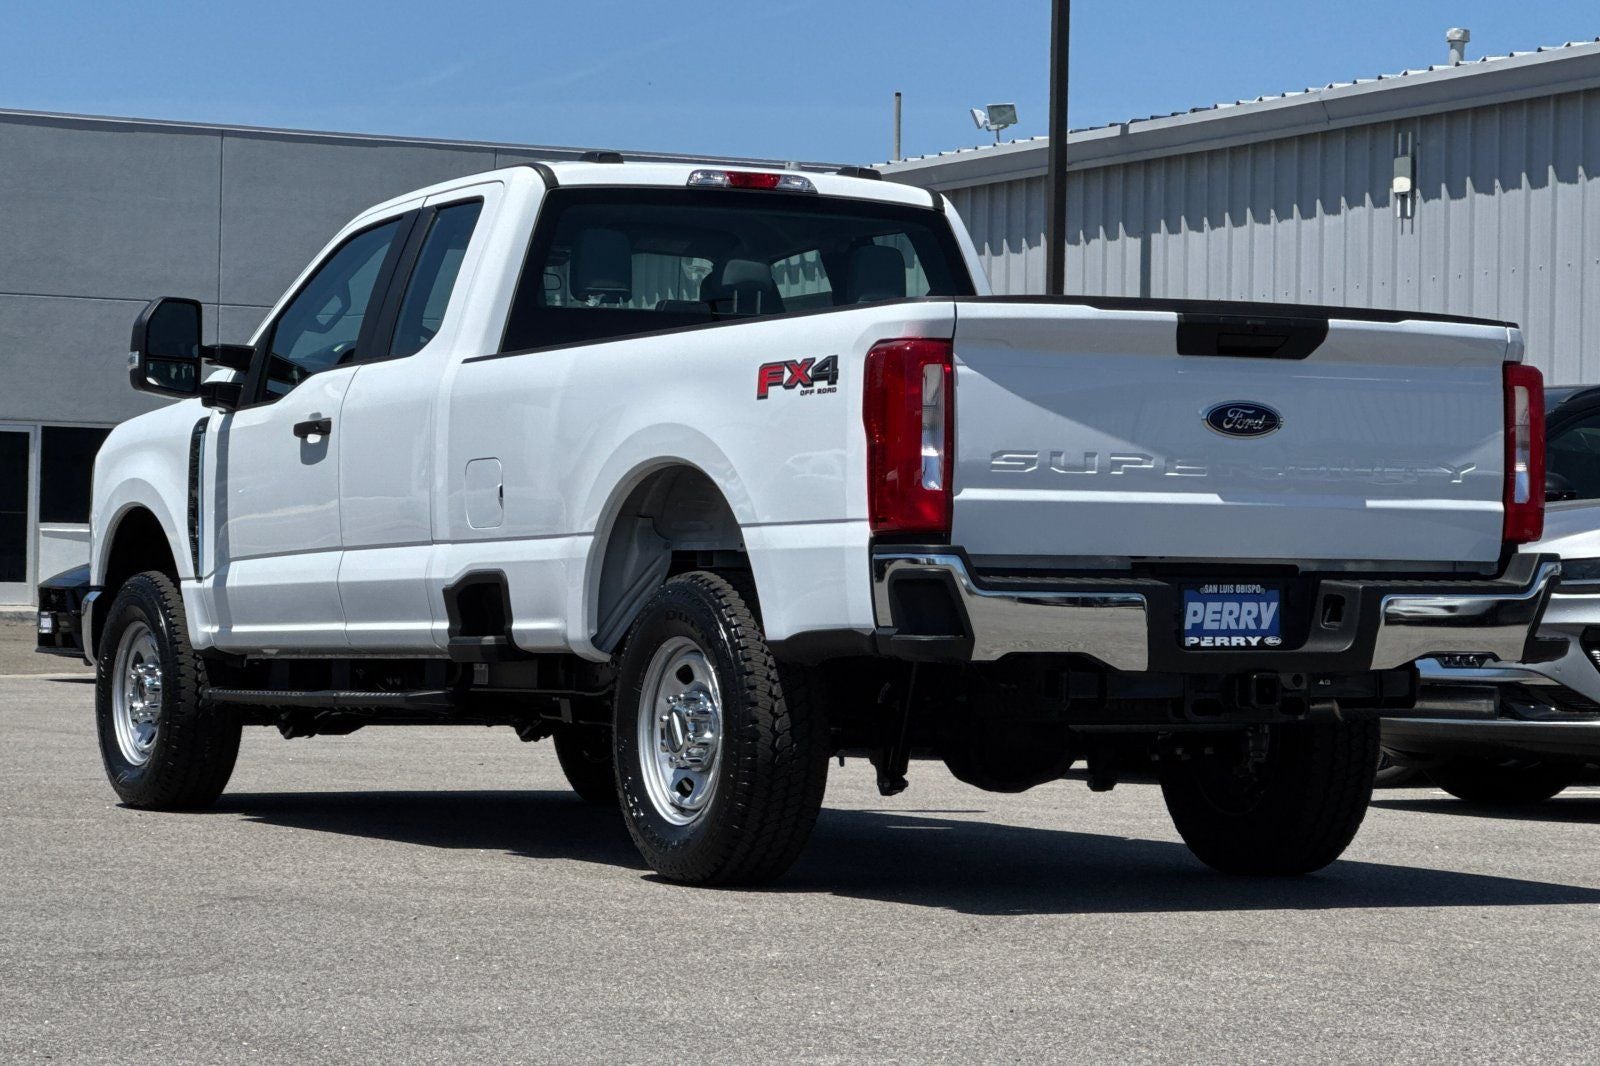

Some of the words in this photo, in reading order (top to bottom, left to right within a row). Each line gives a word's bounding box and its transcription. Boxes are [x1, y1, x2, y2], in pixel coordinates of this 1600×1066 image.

[757, 354, 839, 400] FX4
[817, 387, 837, 395] ROAD
[1222, 407, 1266, 430] Ford
[1204, 584, 1218, 594] SAN
[1219, 584, 1234, 594] LUIS
[1235, 584, 1261, 594] OBISPO
[1184, 601, 1278, 630] PERRY
[1185, 636, 1262, 647] PERRY
